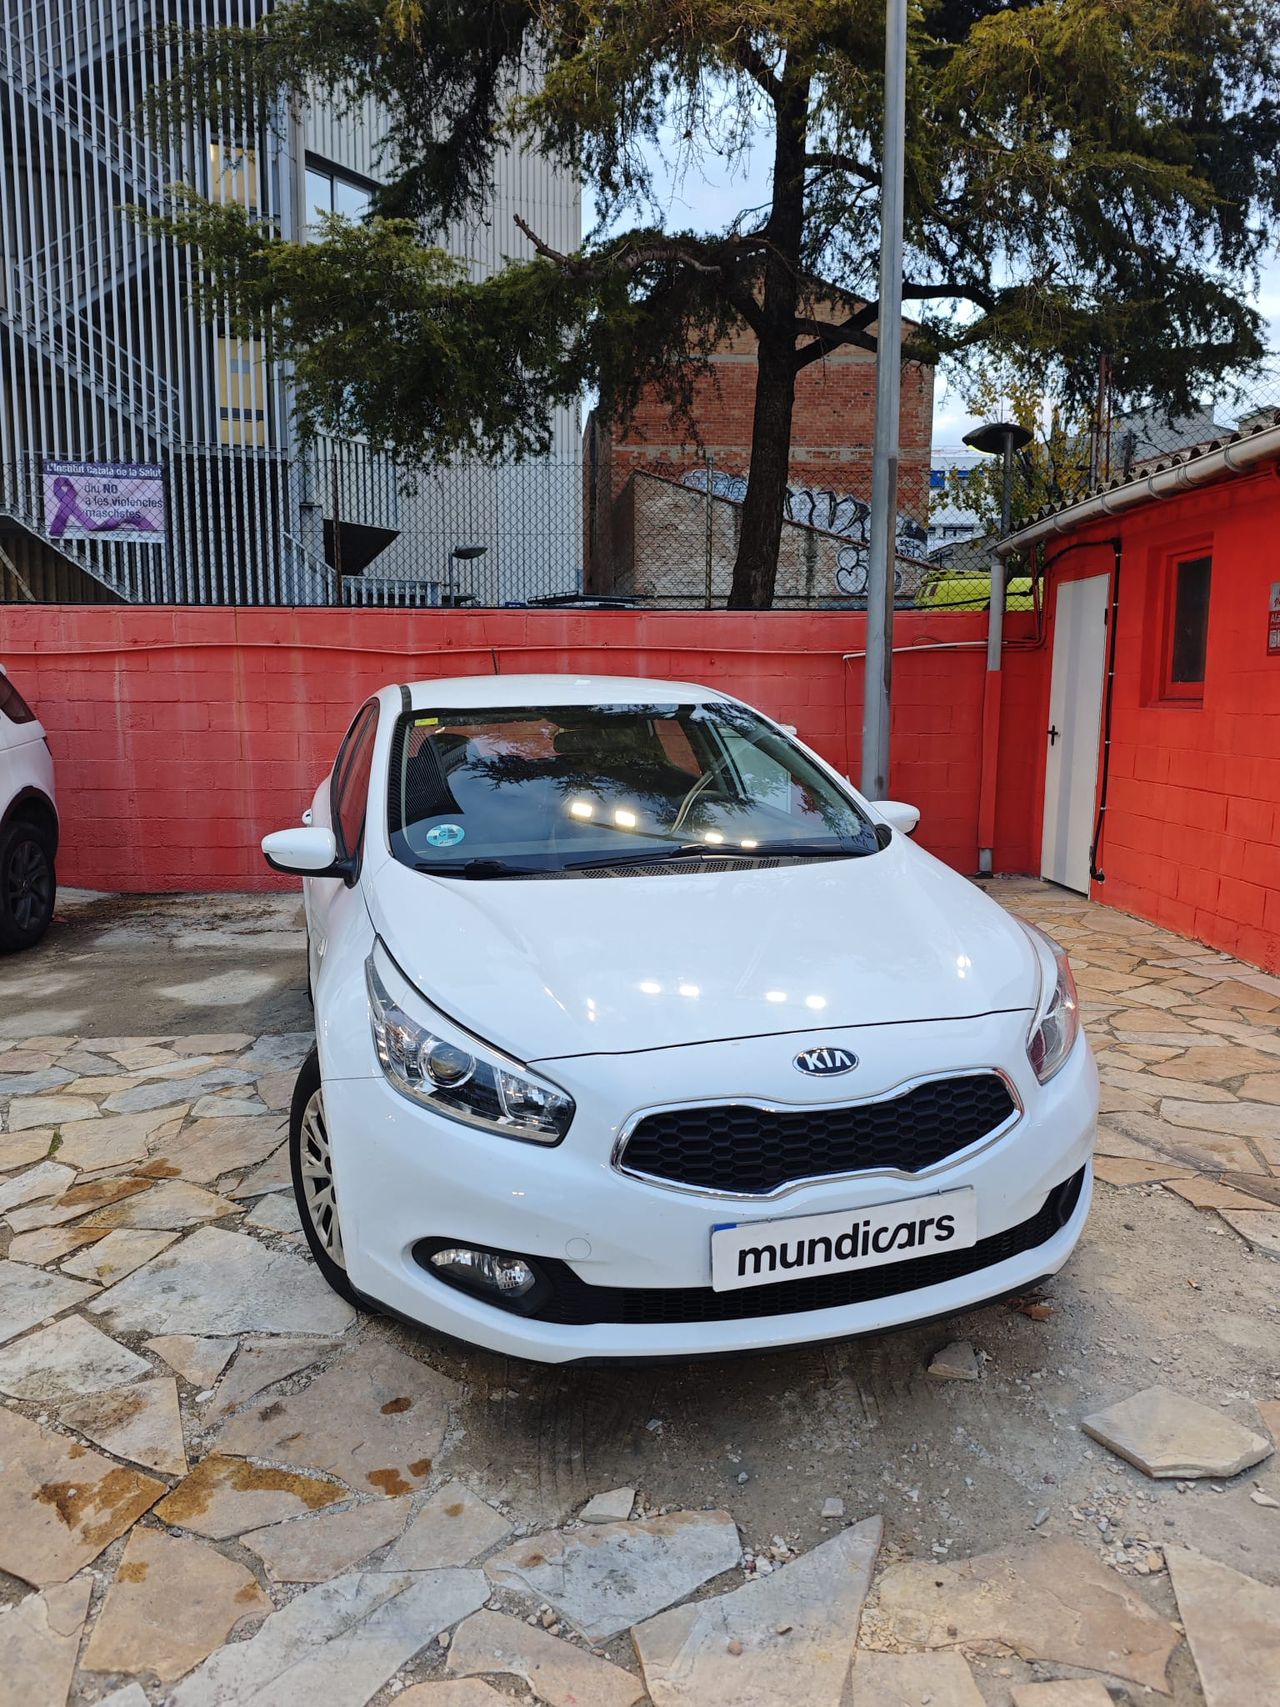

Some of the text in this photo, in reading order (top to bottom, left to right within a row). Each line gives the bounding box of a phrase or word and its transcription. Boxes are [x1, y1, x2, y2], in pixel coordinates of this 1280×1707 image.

[47, 463, 84, 473] L'Institut
[116, 466, 127, 476] de
[129, 467, 137, 476] la
[139, 467, 162, 477] Salut
[103, 484, 118, 494] NO
[85, 498, 91, 506] a
[94, 496, 109, 506] les
[85, 508, 141, 519] masclistes
[803, 1050, 852, 1070] KIA
[737, 1214, 956, 1277] mundicars
